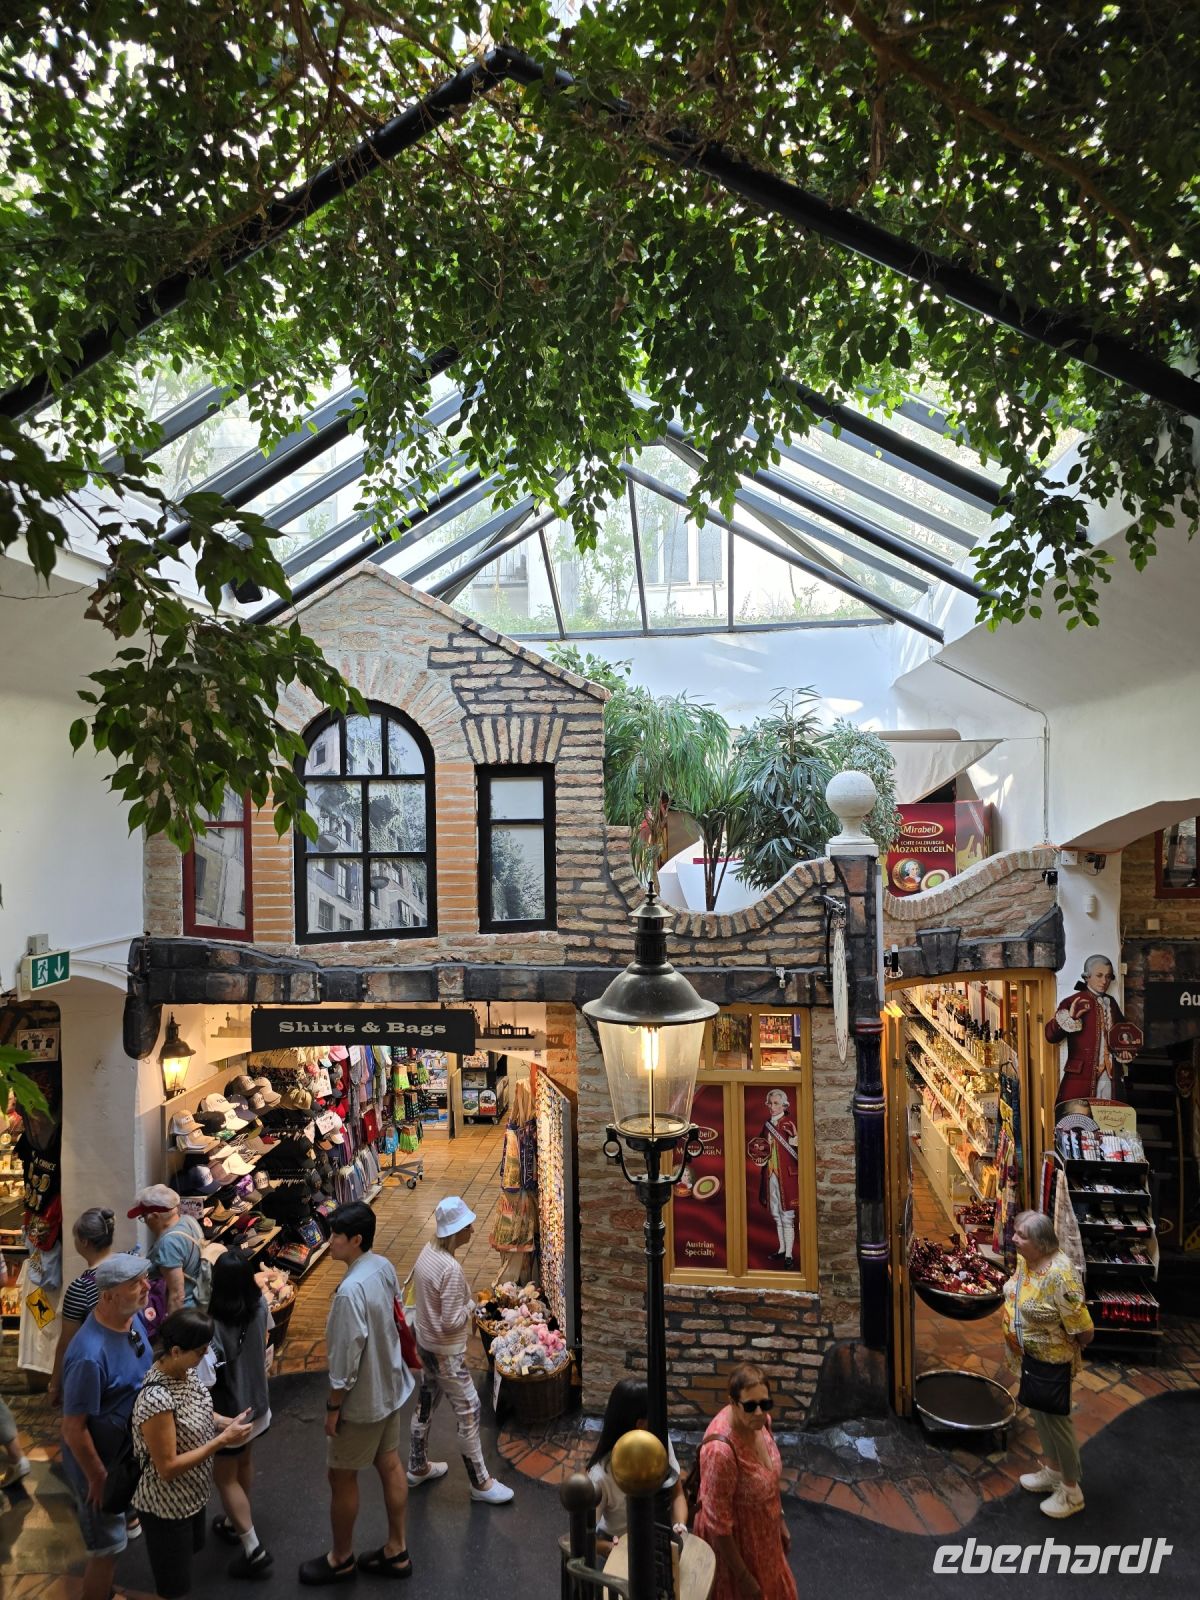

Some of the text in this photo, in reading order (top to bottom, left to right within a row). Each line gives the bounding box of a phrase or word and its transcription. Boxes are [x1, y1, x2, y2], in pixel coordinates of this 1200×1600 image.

[903, 825, 937, 834] Mirabell
[889, 844, 954, 853] MOZARTKUGELN
[278, 1021, 447, 1037] Shirts & Bags
[686, 1240, 715, 1248] Austrian
[684, 1248, 715, 1258] Specialty
